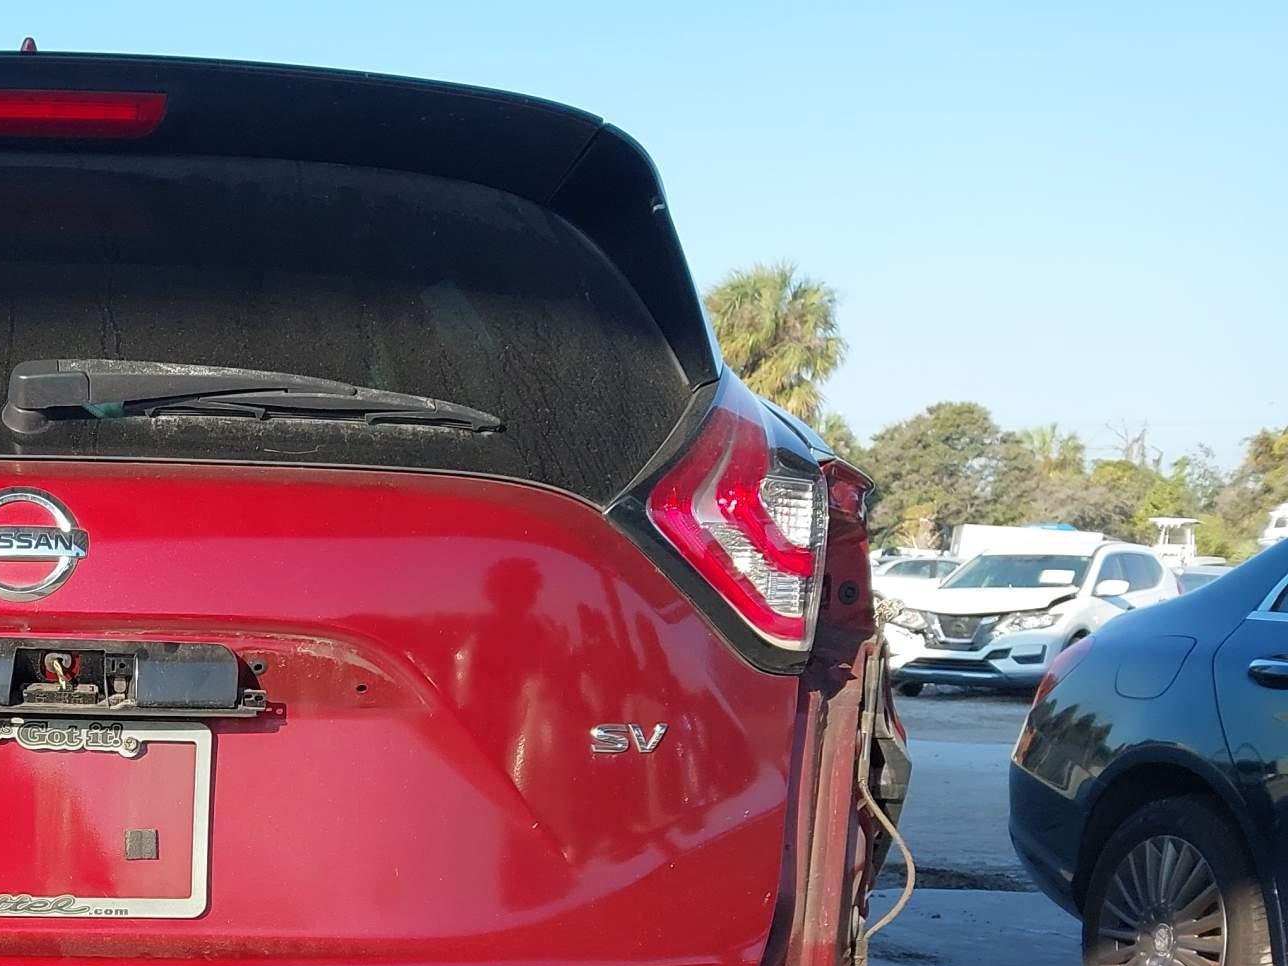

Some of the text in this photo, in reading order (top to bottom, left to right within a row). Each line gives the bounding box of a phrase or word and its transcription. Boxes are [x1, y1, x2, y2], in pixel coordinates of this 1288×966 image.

[18, 721, 82, 747] Got
[86, 722, 124, 748] it!
[590, 723, 669, 752] SV
